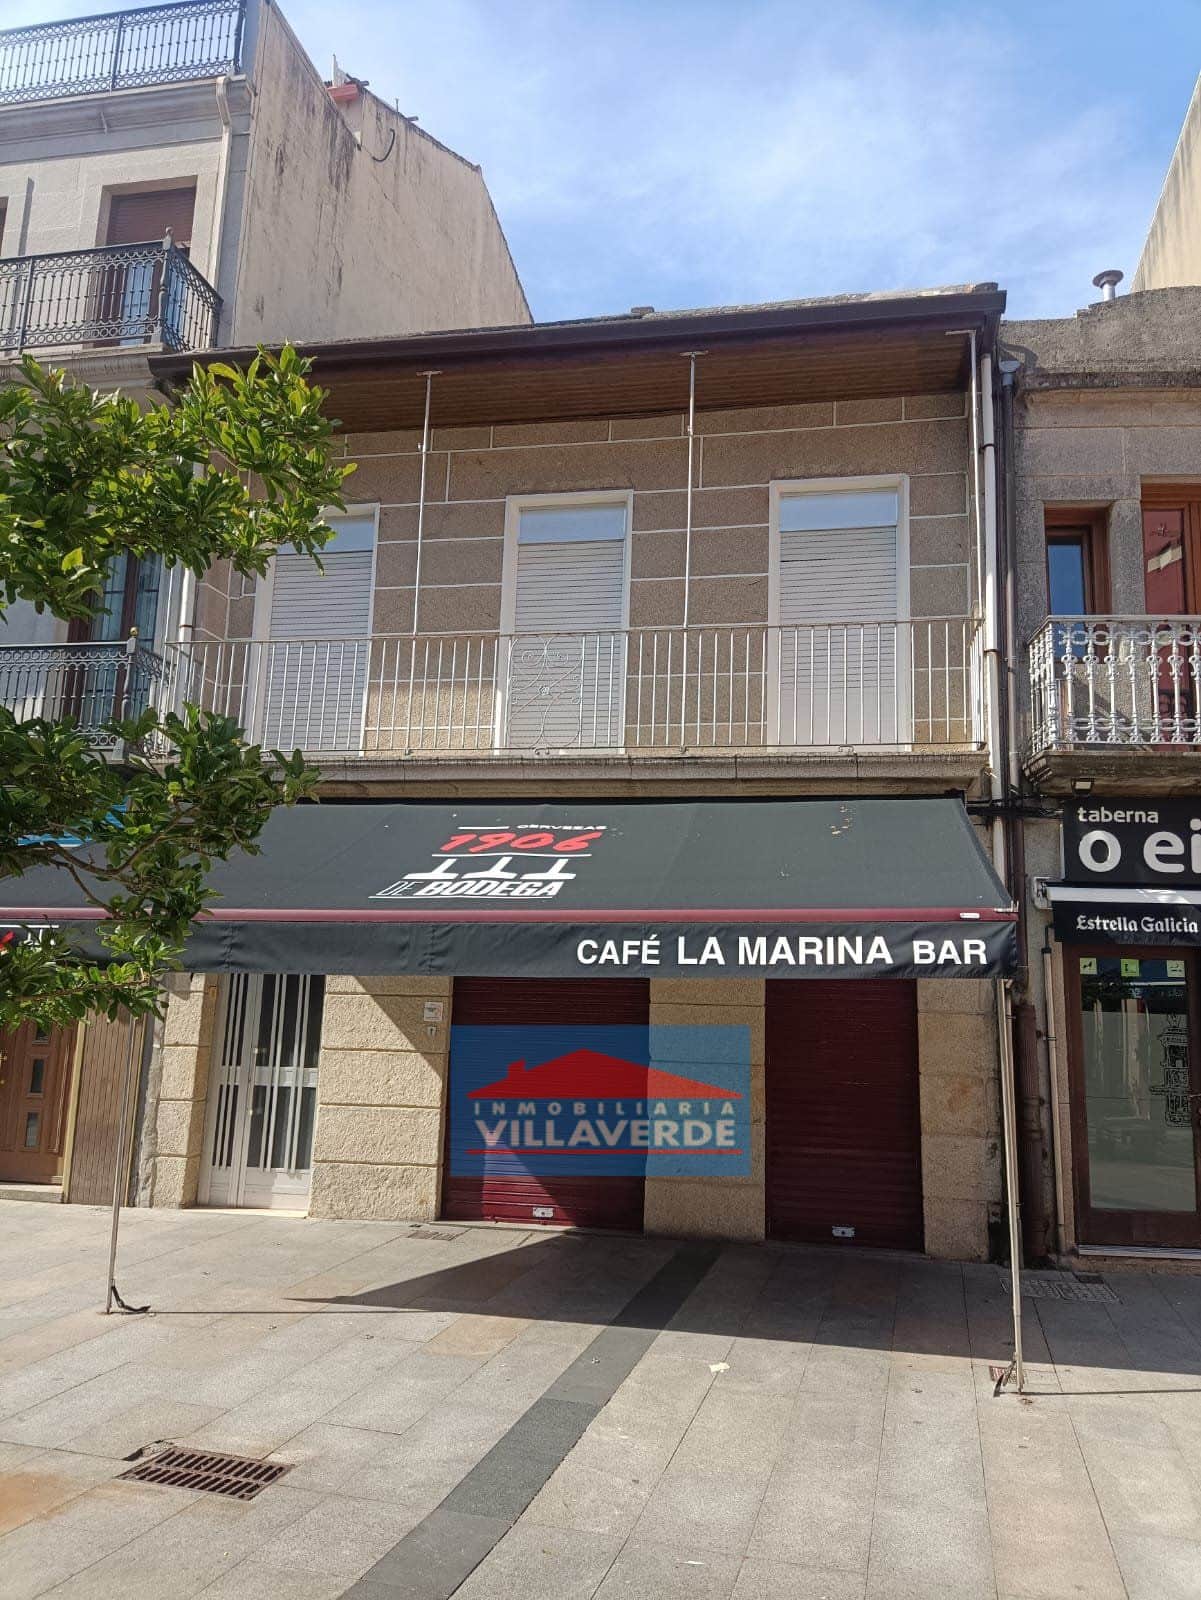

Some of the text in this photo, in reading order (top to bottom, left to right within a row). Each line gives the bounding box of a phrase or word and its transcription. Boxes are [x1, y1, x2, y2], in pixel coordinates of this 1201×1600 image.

[1078, 806, 1159, 823] taberna
[440, 831, 603, 853] 1906
[1078, 818, 1201, 874] o ei
[376, 880, 564, 896] DE BODEGA
[1076, 915, 1198, 933] Estrella Galicia
[577, 935, 988, 965] CAFÉ LA MARINA BAR
